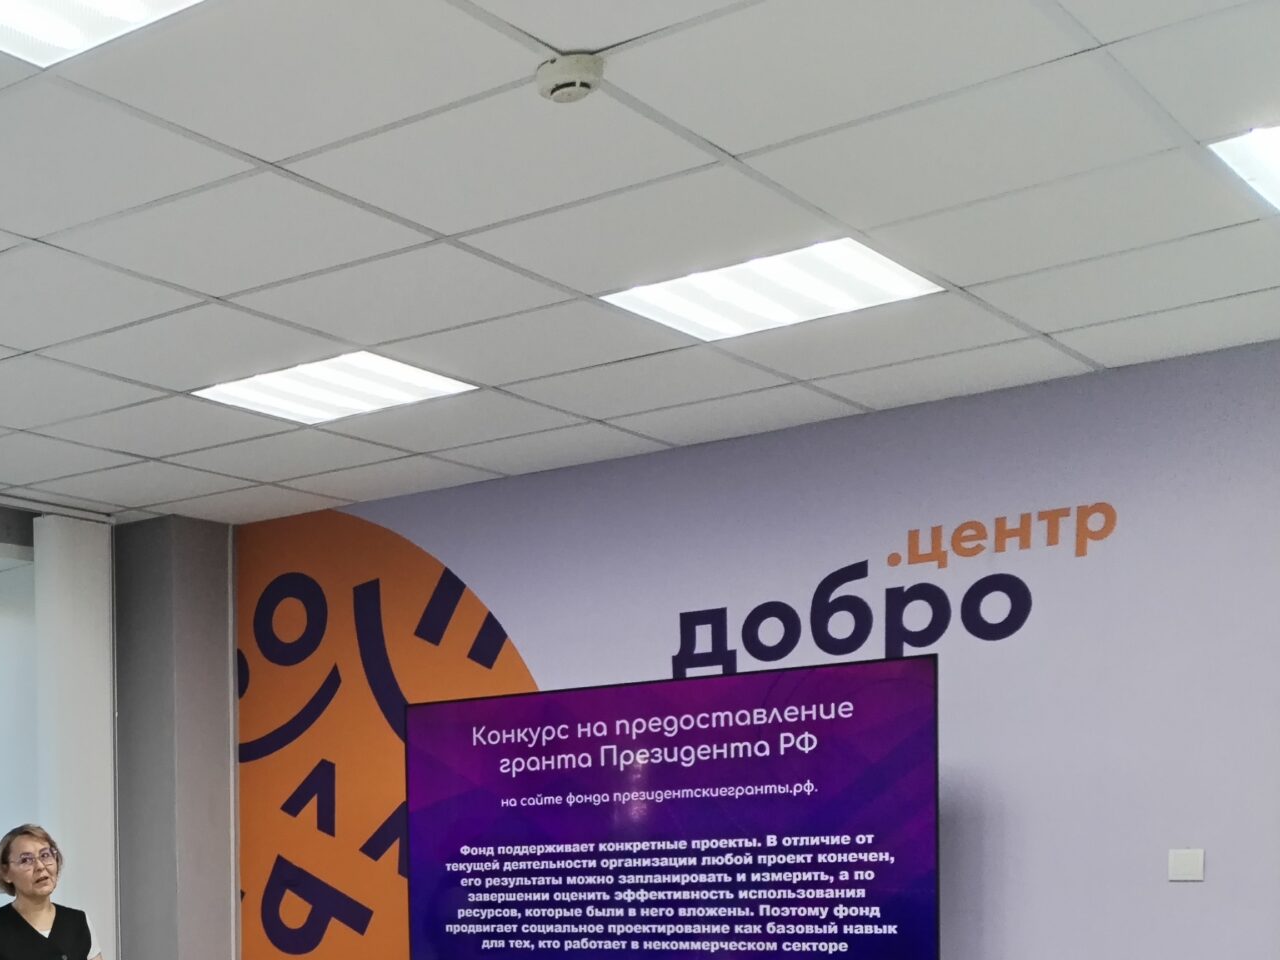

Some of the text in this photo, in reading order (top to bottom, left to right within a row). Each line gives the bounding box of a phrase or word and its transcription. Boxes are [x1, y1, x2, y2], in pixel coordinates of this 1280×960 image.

[887, 502, 1118, 569] .центр
[672, 559, 1033, 679] добро
[471, 700, 854, 748] Конкурс на предоставление
[498, 730, 818, 777] гранта Президента РФ
[500, 780, 818, 808] на сайте фонда президентскиегранты.рф.
[458, 833, 875, 857] Фонд поддерживает конкретные проекты. В отличие от
[444, 850, 895, 874] текущей деятельности организации любой проект конечен,
[459, 869, 876, 888] его результаты можно запланировать и измерить, а по
[466, 887, 866, 904] завершении оценить эффективность использования
[456, 903, 881, 920] ресурсов, которые были в него вложены. Поэтому фонд
[444, 921, 898, 936] продвигает социальное проектирование как базовый навык
[480, 937, 849, 955] для тех, кто работает в некоммерческом секторе
